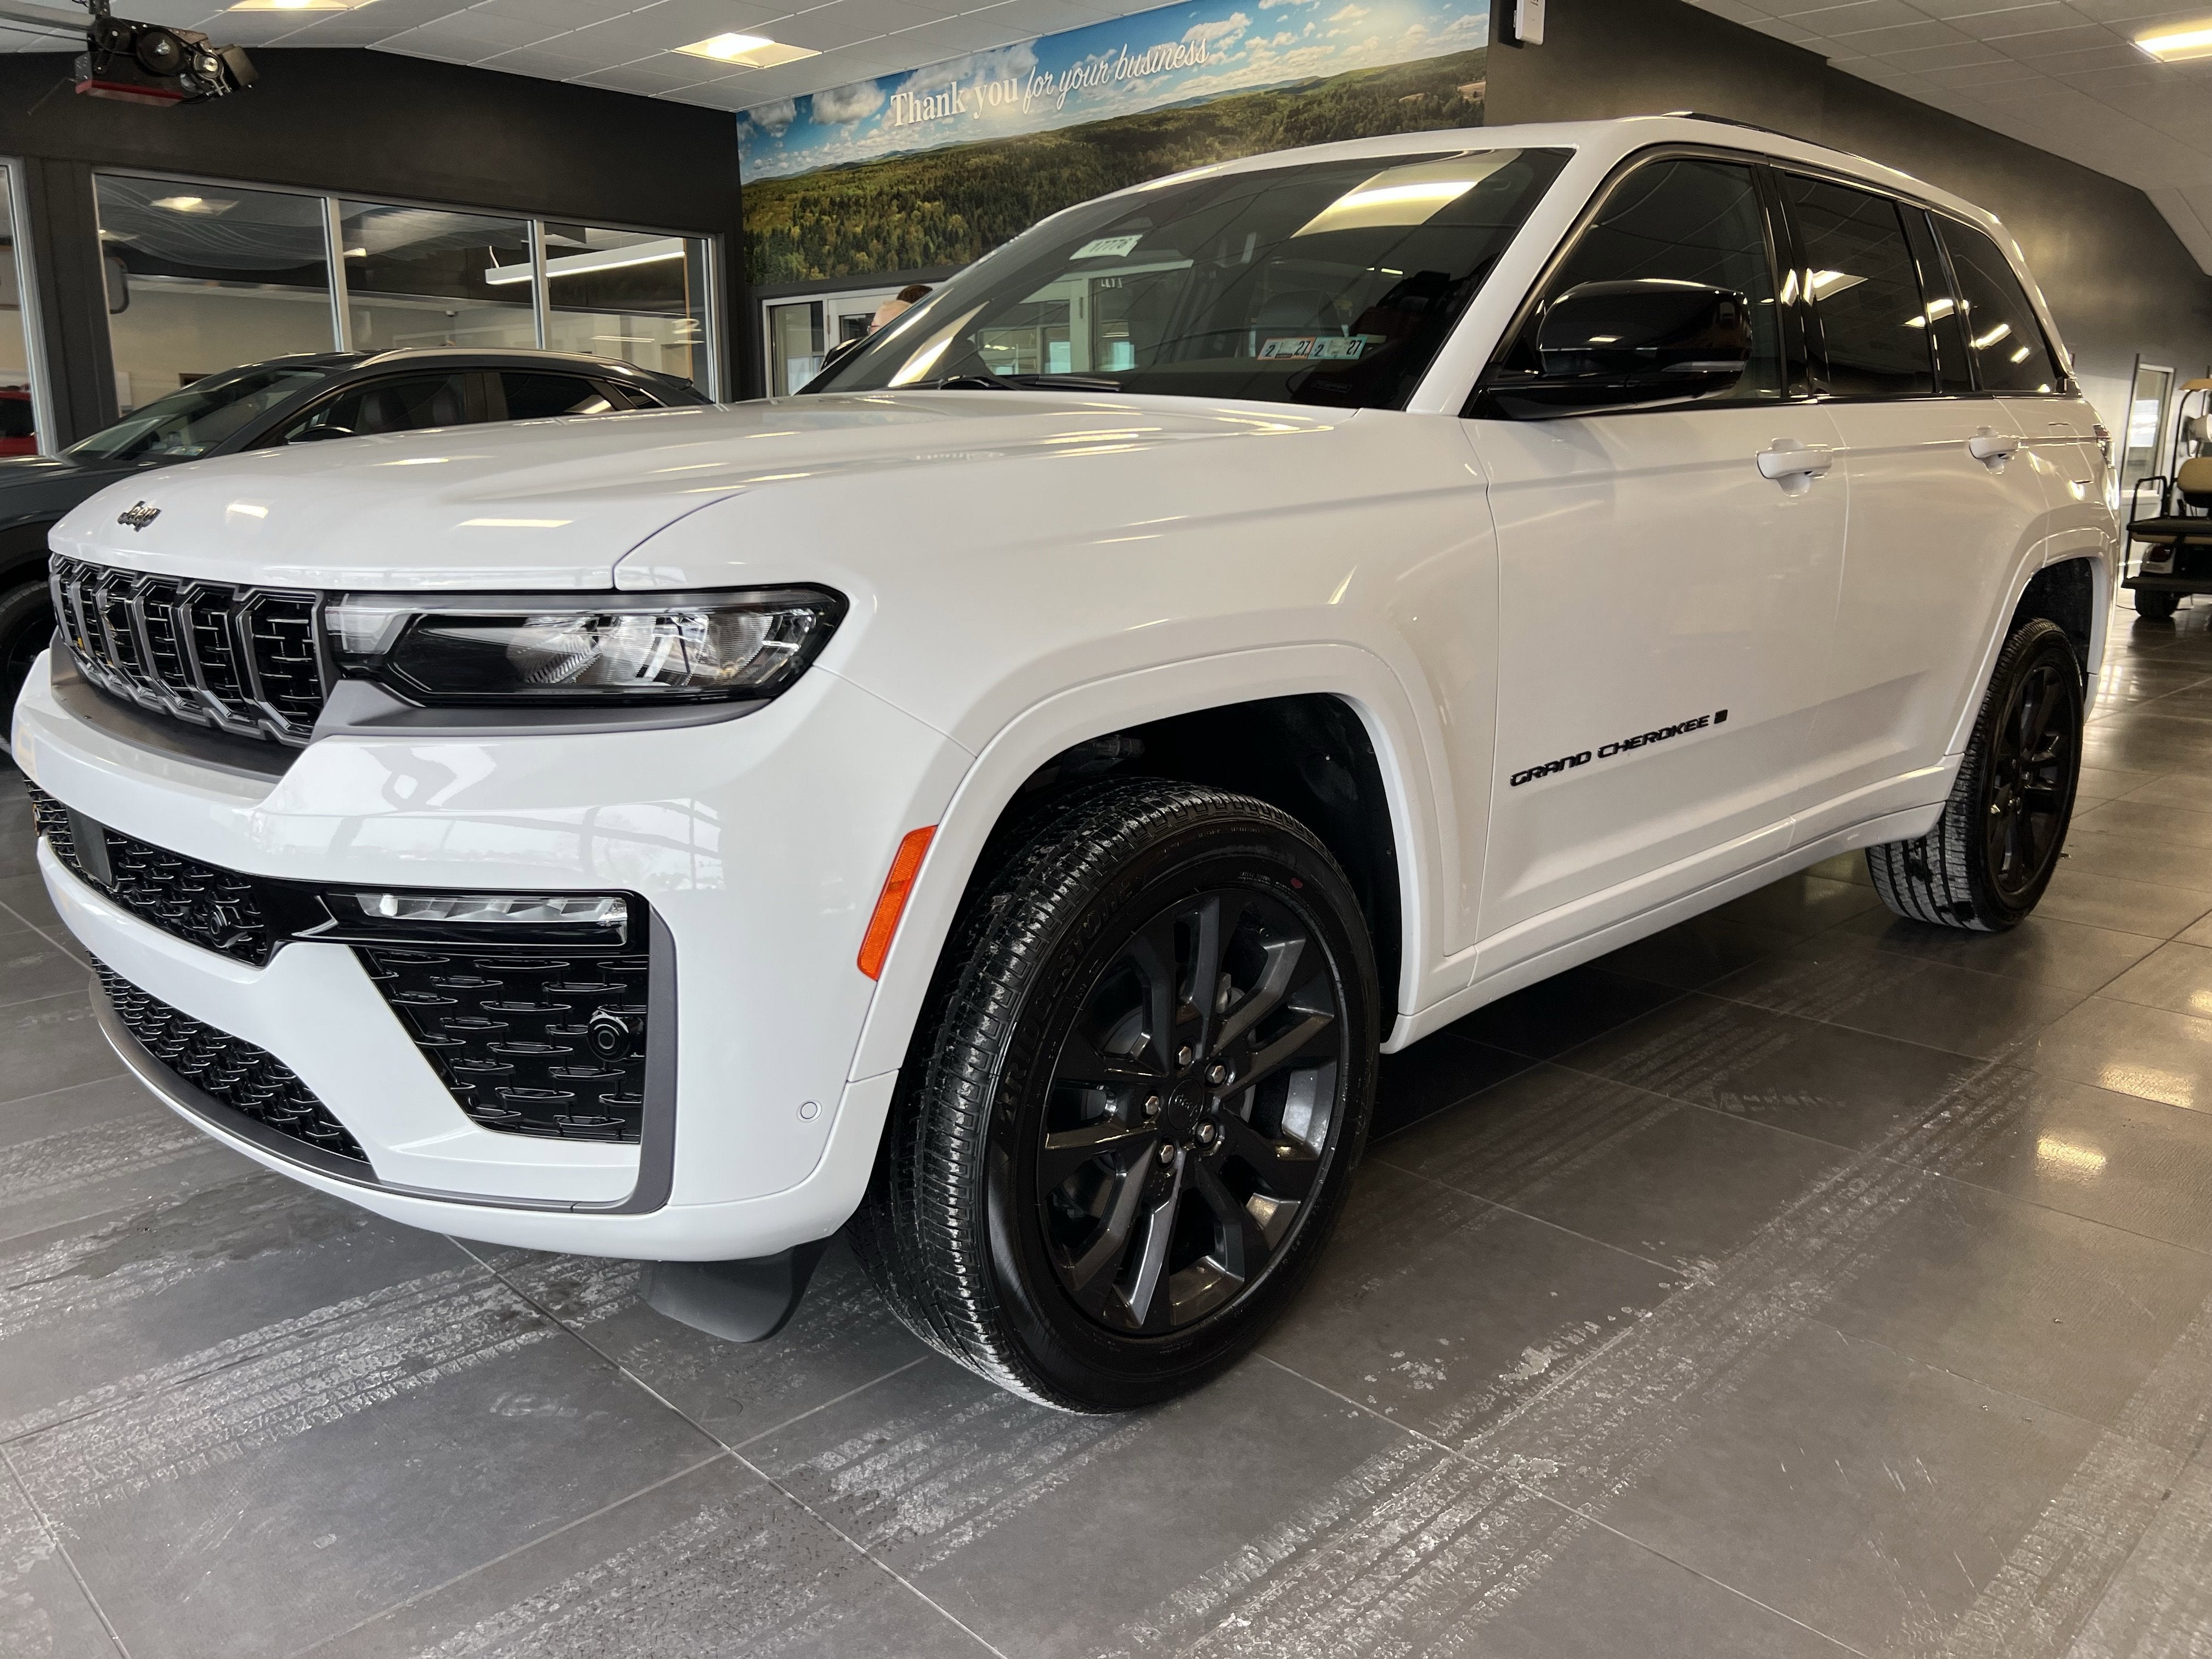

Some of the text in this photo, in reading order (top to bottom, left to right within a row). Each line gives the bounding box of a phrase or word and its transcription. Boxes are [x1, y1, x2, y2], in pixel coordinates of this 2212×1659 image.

[890, 37, 1210, 127] Thank you for your business
[117, 500, 161, 532] Jeep
[1510, 715, 1710, 787] GRAND CHEROKEE
